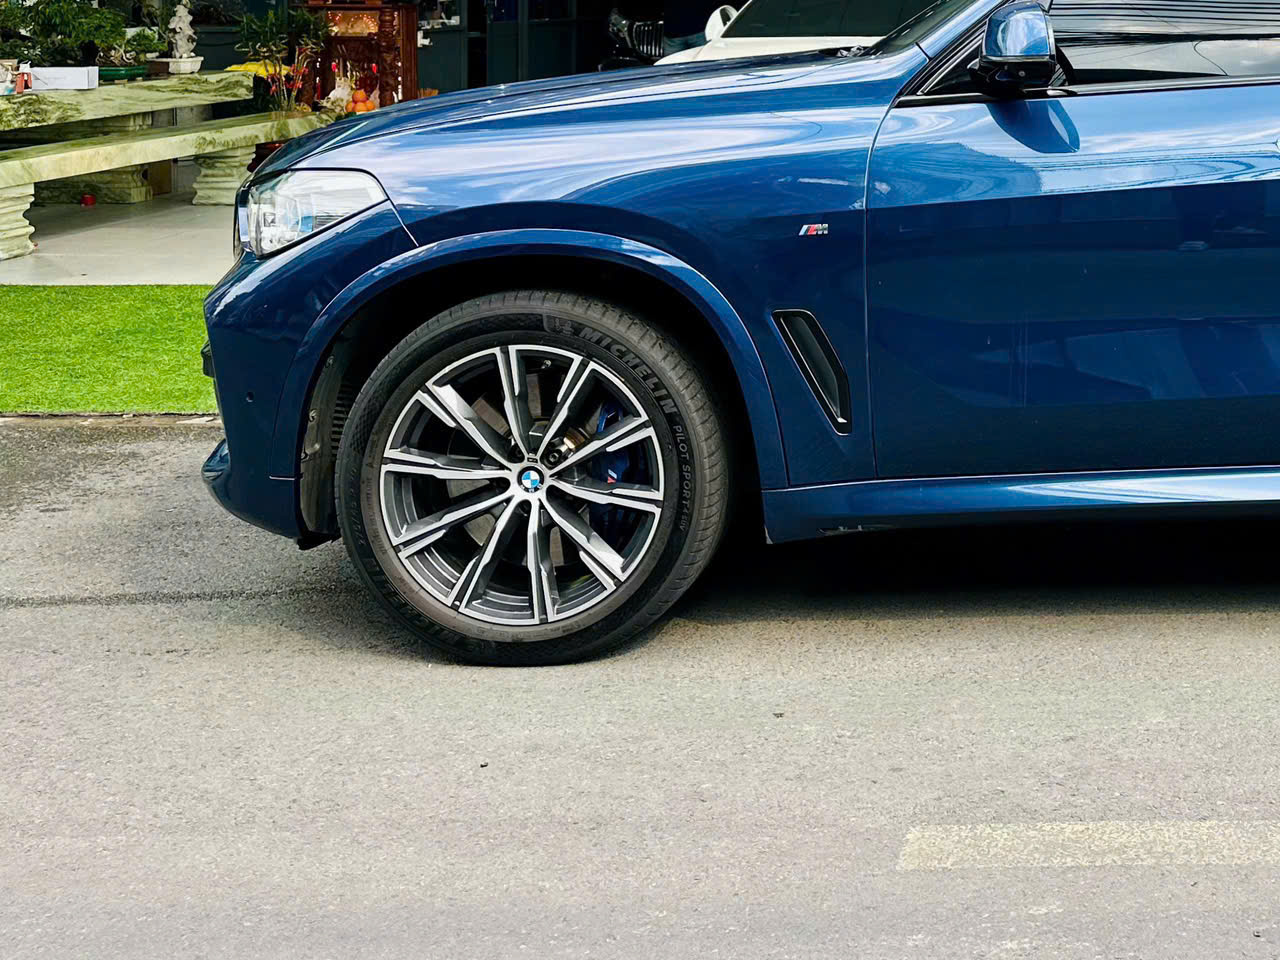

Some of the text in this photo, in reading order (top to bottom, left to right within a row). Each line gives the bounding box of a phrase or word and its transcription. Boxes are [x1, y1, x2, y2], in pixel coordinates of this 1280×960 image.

[578, 326, 678, 414] MICHELIN
[673, 425, 690, 460] PILOT
[681, 464, 692, 507] SPORT
